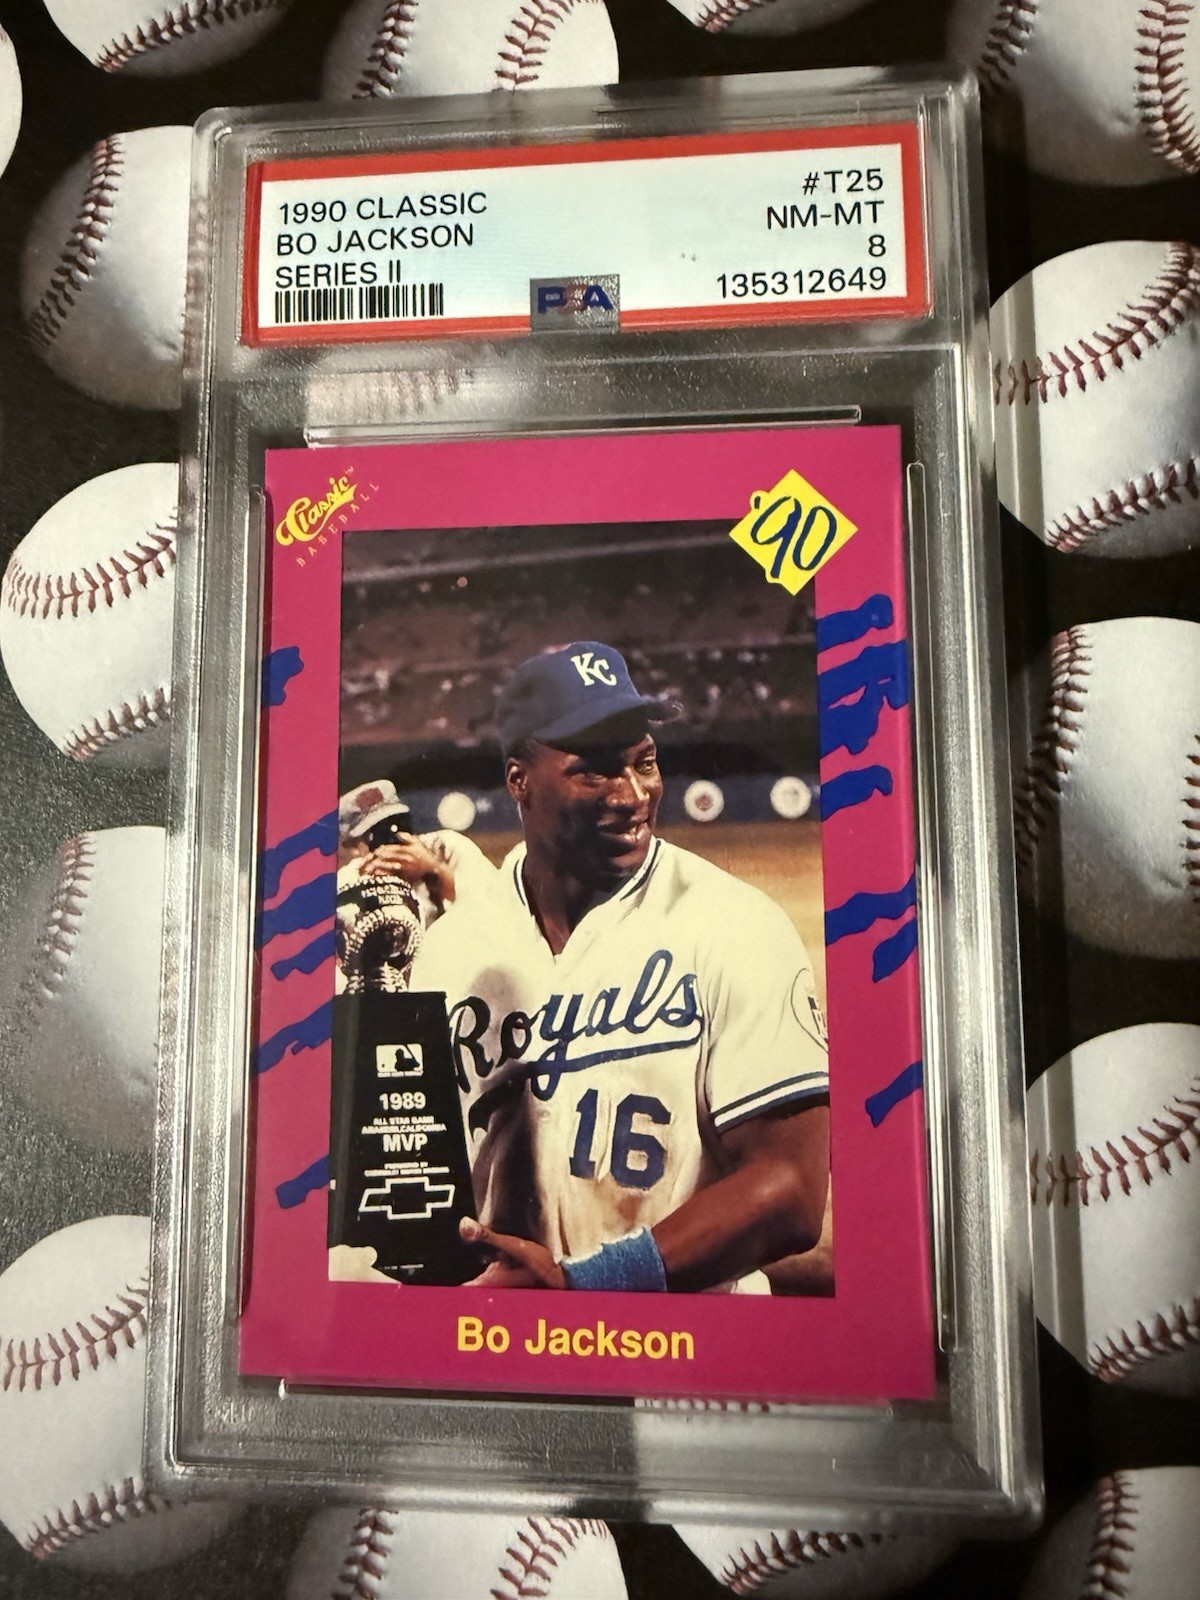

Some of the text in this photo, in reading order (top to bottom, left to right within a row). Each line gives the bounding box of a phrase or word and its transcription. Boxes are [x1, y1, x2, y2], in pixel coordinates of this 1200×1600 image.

[802, 168, 884, 195] #T25
[279, 192, 487, 225] 1990 CLASSIC
[766, 201, 884, 229] NM-MT
[277, 223, 473, 256] BO JACKSON
[867, 235, 887, 257] 8
[275, 260, 401, 289] SERIES II
[716, 266, 887, 298] 135312649
[275, 477, 358, 546] Classic
[296, 483, 380, 568] BASEBALL
[750, 495, 838, 579] '90
[570, 652, 617, 686] KC
[449, 949, 703, 1101] Royals
[378, 1091, 427, 1111] 1989
[383, 1133, 428, 1152] MVP
[568, 1088, 672, 1191] 16
[457, 1316, 695, 1359] Bo Jackson
